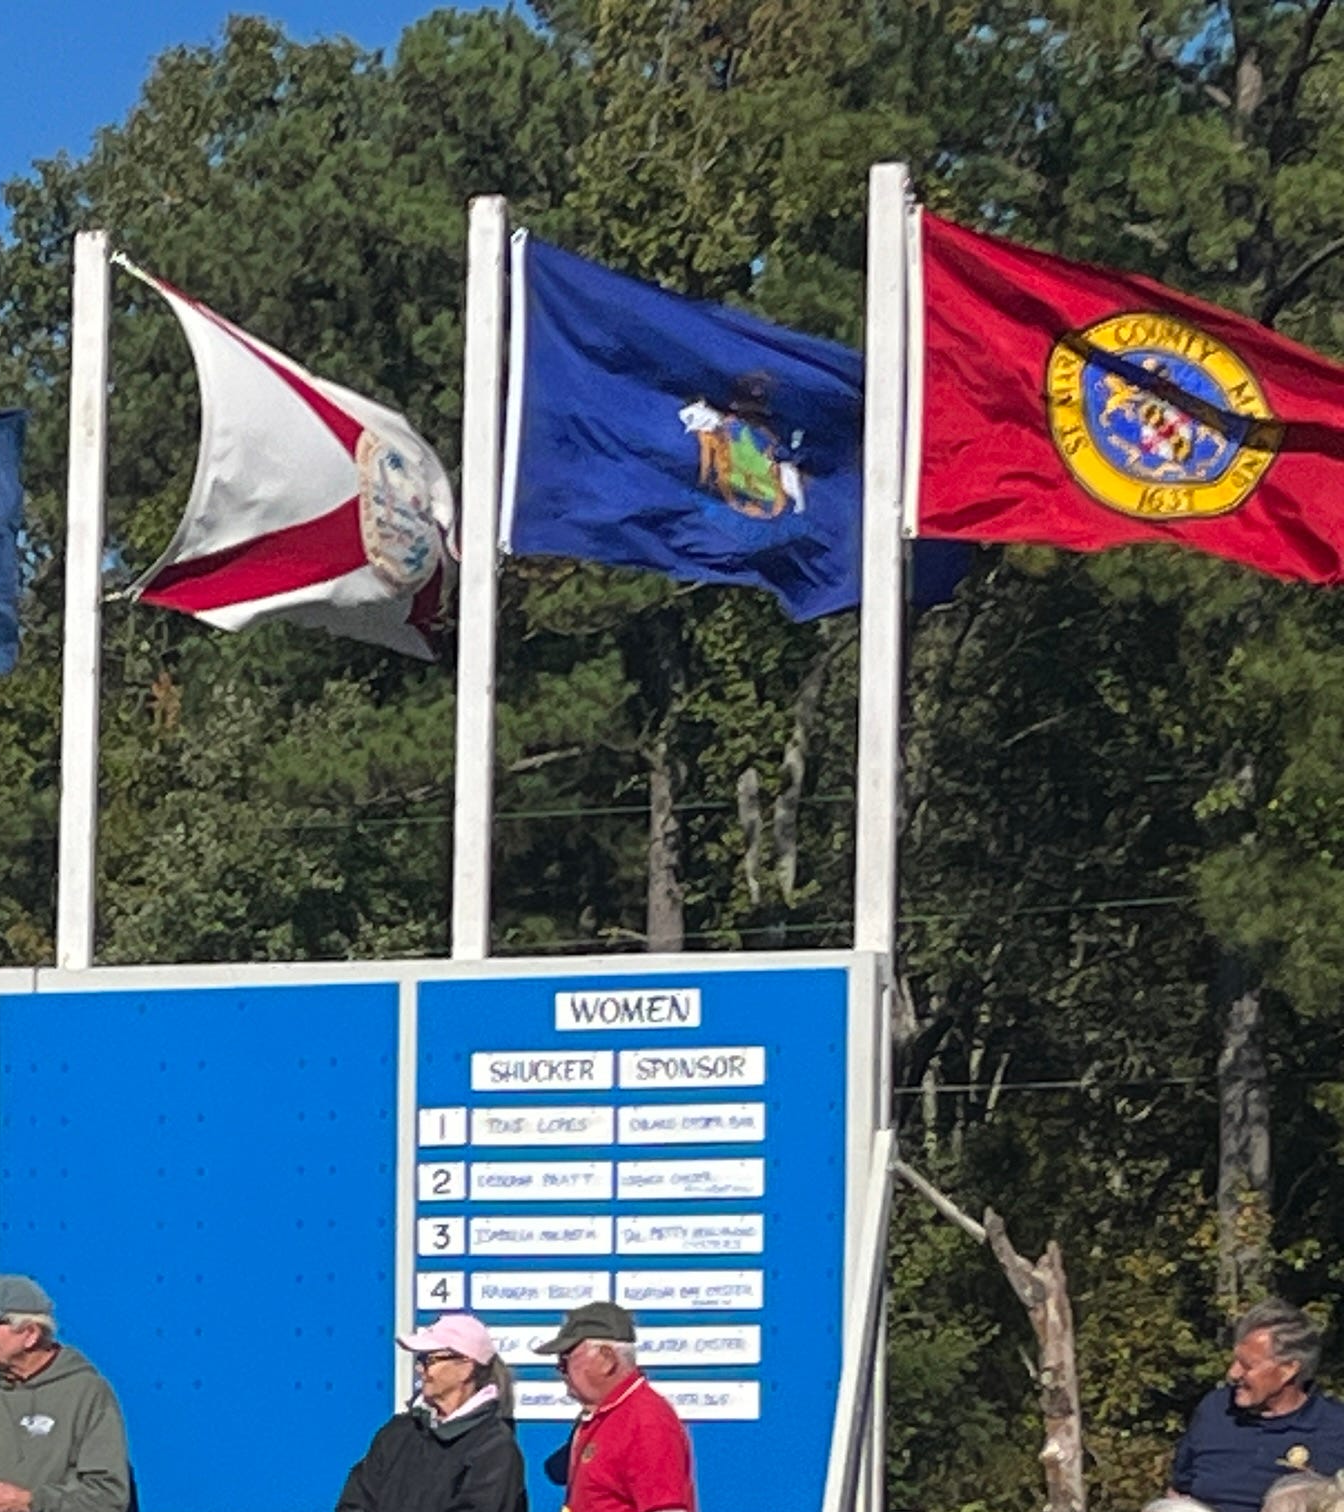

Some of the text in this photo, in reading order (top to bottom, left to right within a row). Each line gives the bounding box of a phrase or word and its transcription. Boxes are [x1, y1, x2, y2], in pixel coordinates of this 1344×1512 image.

[570, 994, 691, 1024] WOMEN
[490, 1054, 747, 1084] SHUCKER SPONSOR
[439, 1113, 446, 1140] 1
[432, 1168, 452, 1196] 2
[432, 1223, 451, 1251] 3
[430, 1277, 450, 1304] 4
